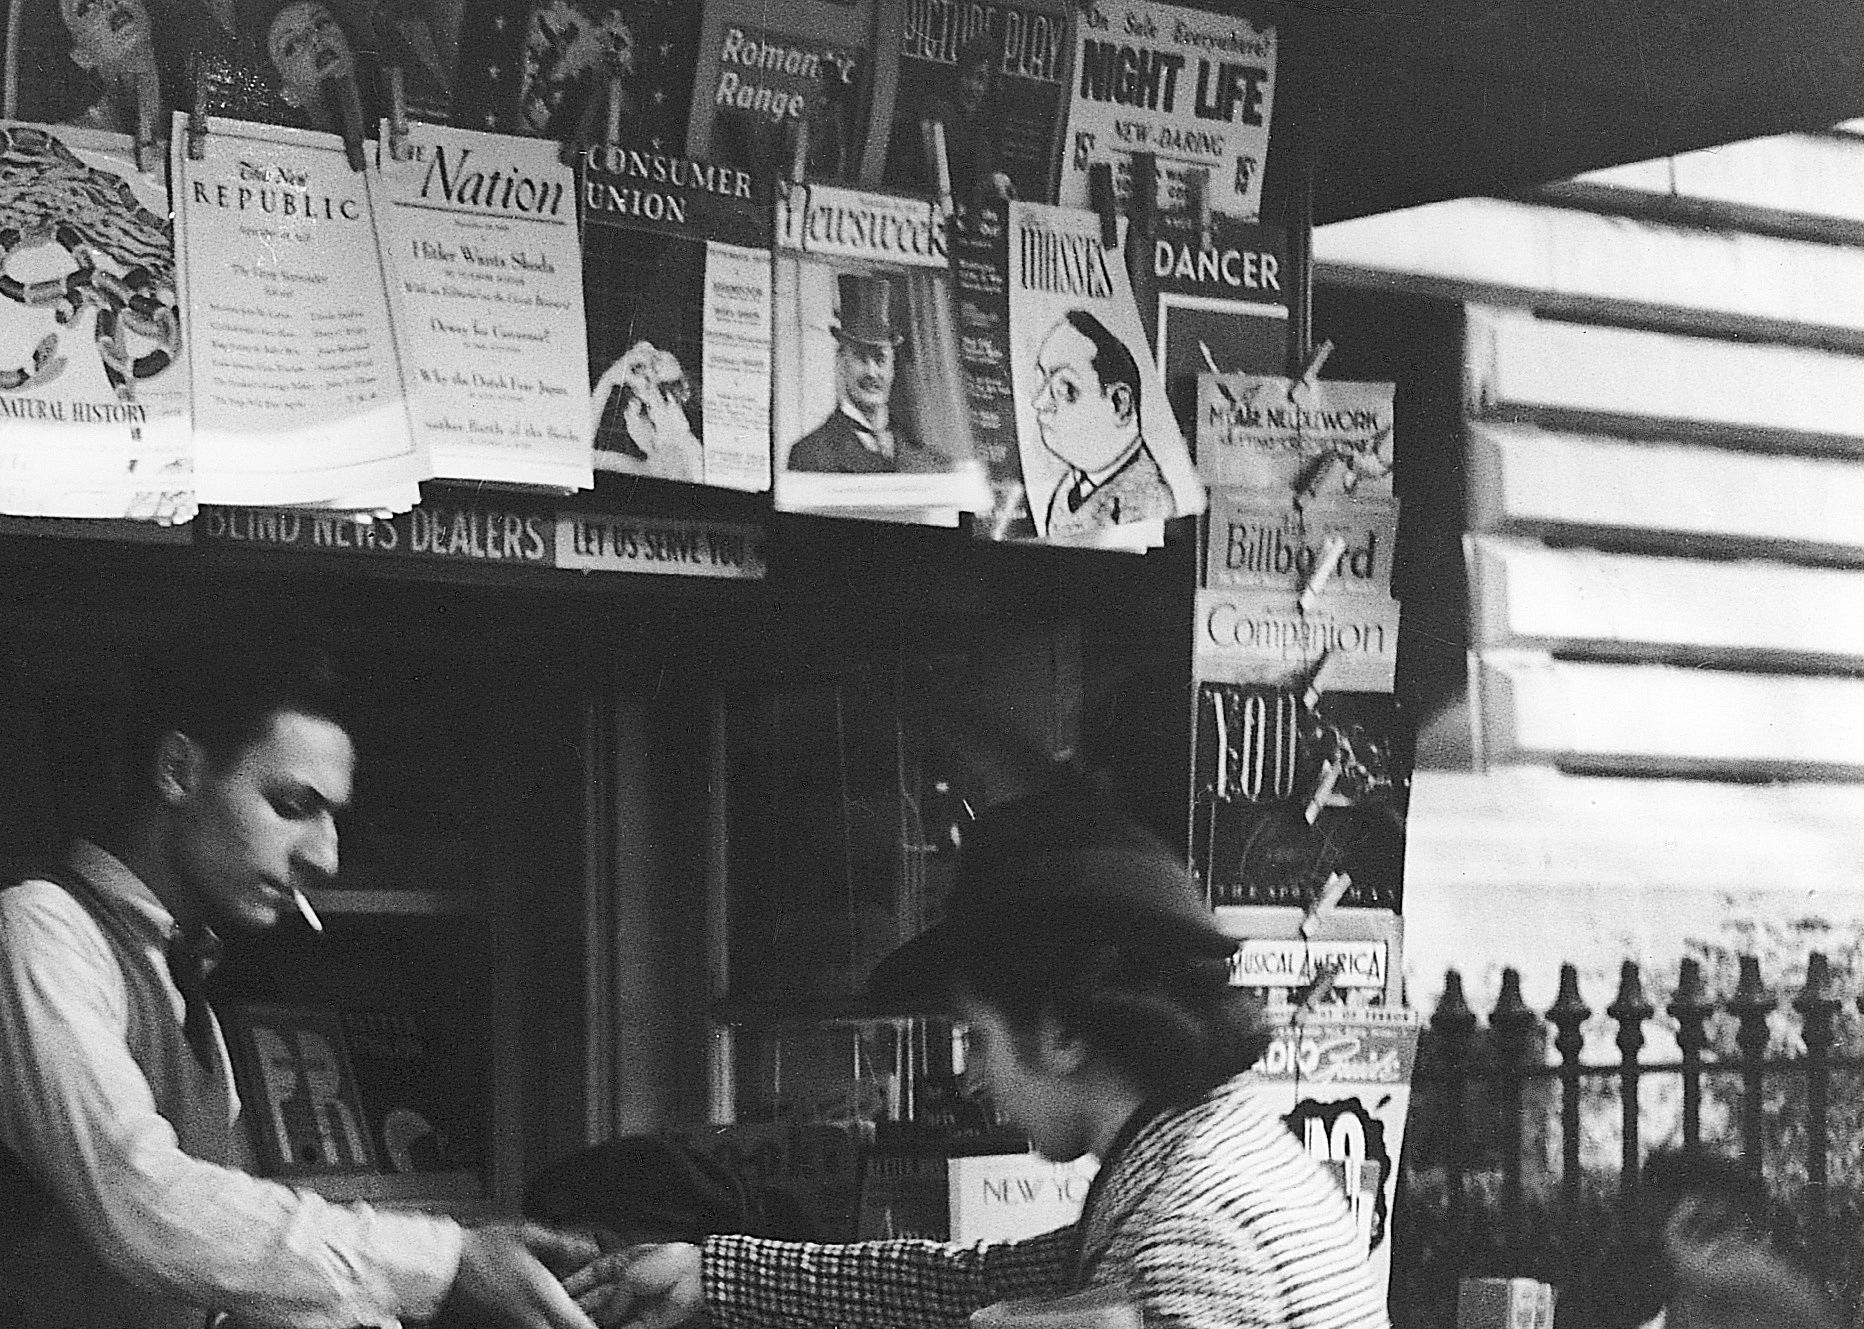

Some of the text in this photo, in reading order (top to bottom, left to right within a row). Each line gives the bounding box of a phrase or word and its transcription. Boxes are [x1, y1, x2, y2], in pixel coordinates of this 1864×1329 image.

[716, 72, 804, 122] Range
[1080, 38, 1268, 127] NIGHT LIFE
[421, 144, 565, 216] Nation
[587, 143, 751, 199] CONSUMER
[193, 180, 361, 221] REPUBLIC
[586, 181, 686, 223] UNION
[1154, 240, 1281, 291] DANCER
[71, 399, 149, 424] HISTORY
[410, 510, 546, 561] DEALERS
[1226, 521, 1378, 579] Billbord
